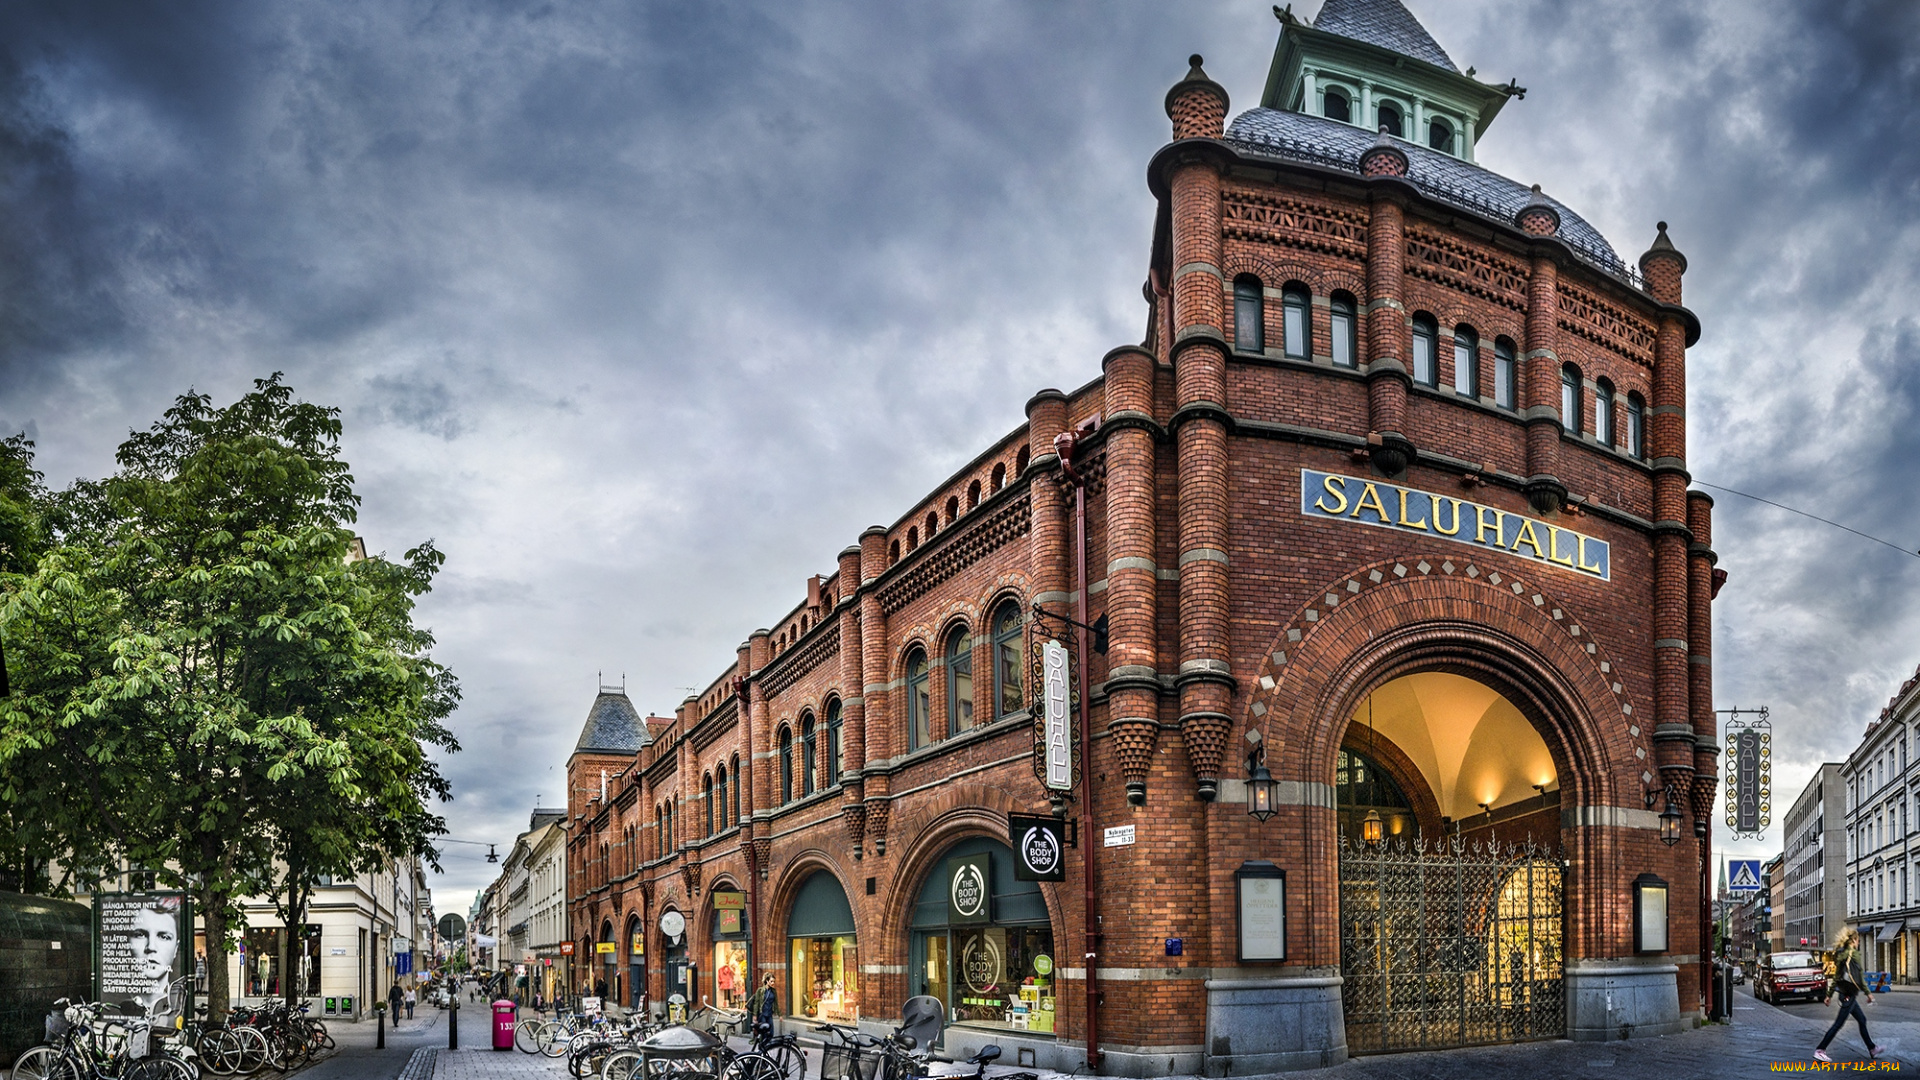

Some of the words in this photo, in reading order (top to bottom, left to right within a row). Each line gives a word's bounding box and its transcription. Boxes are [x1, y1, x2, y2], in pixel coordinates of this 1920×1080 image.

[1314, 475, 1602, 574] SALUHALL
[1048, 649, 1067, 785] SALUHALL
[1740, 734, 1755, 828] SALUHALL
[1033, 840, 1048, 849] THE
[1029, 848, 1052, 857] BODY
[1031, 856, 1052, 865] SHOP
[962, 879, 974, 888] THE
[958, 887, 978, 898] BODY
[103, 901, 125, 909] MÅNGA
[959, 897, 978, 907] SHOP
[109, 934, 128, 942] LÅTER
[973, 952, 988, 961] THE
[969, 961, 993, 971] BODY
[970, 972, 993, 983] SHOP
